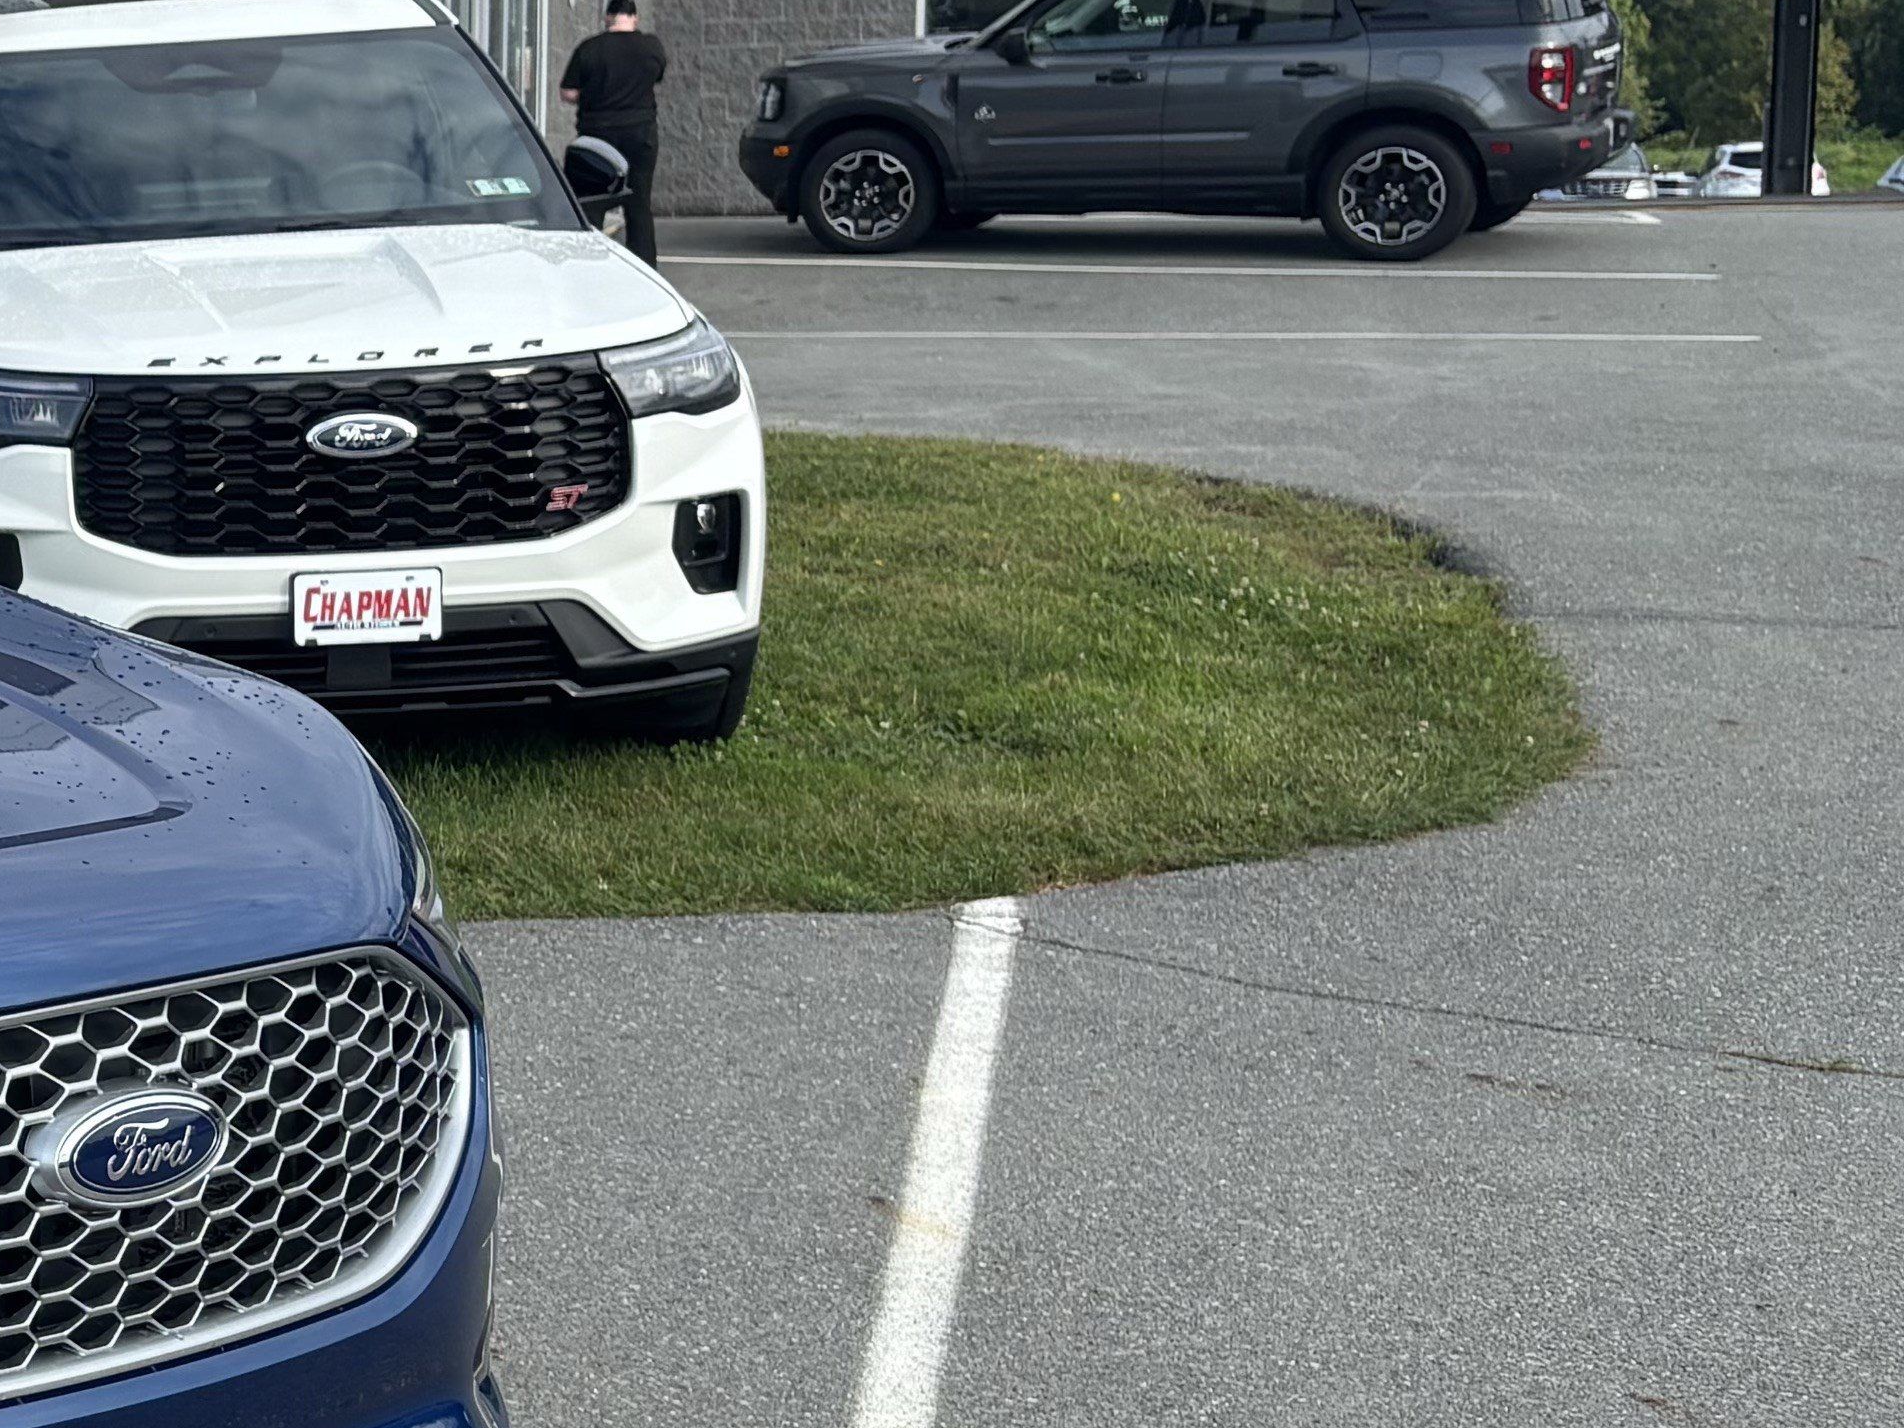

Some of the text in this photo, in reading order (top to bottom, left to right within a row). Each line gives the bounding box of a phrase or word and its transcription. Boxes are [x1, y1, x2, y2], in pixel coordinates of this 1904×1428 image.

[147, 338, 544, 368] EXPLORER
[334, 422, 392, 448] Ford
[546, 483, 589, 512] ST
[303, 586, 432, 623] CHAPMAN
[106, 1117, 193, 1182] Ford
